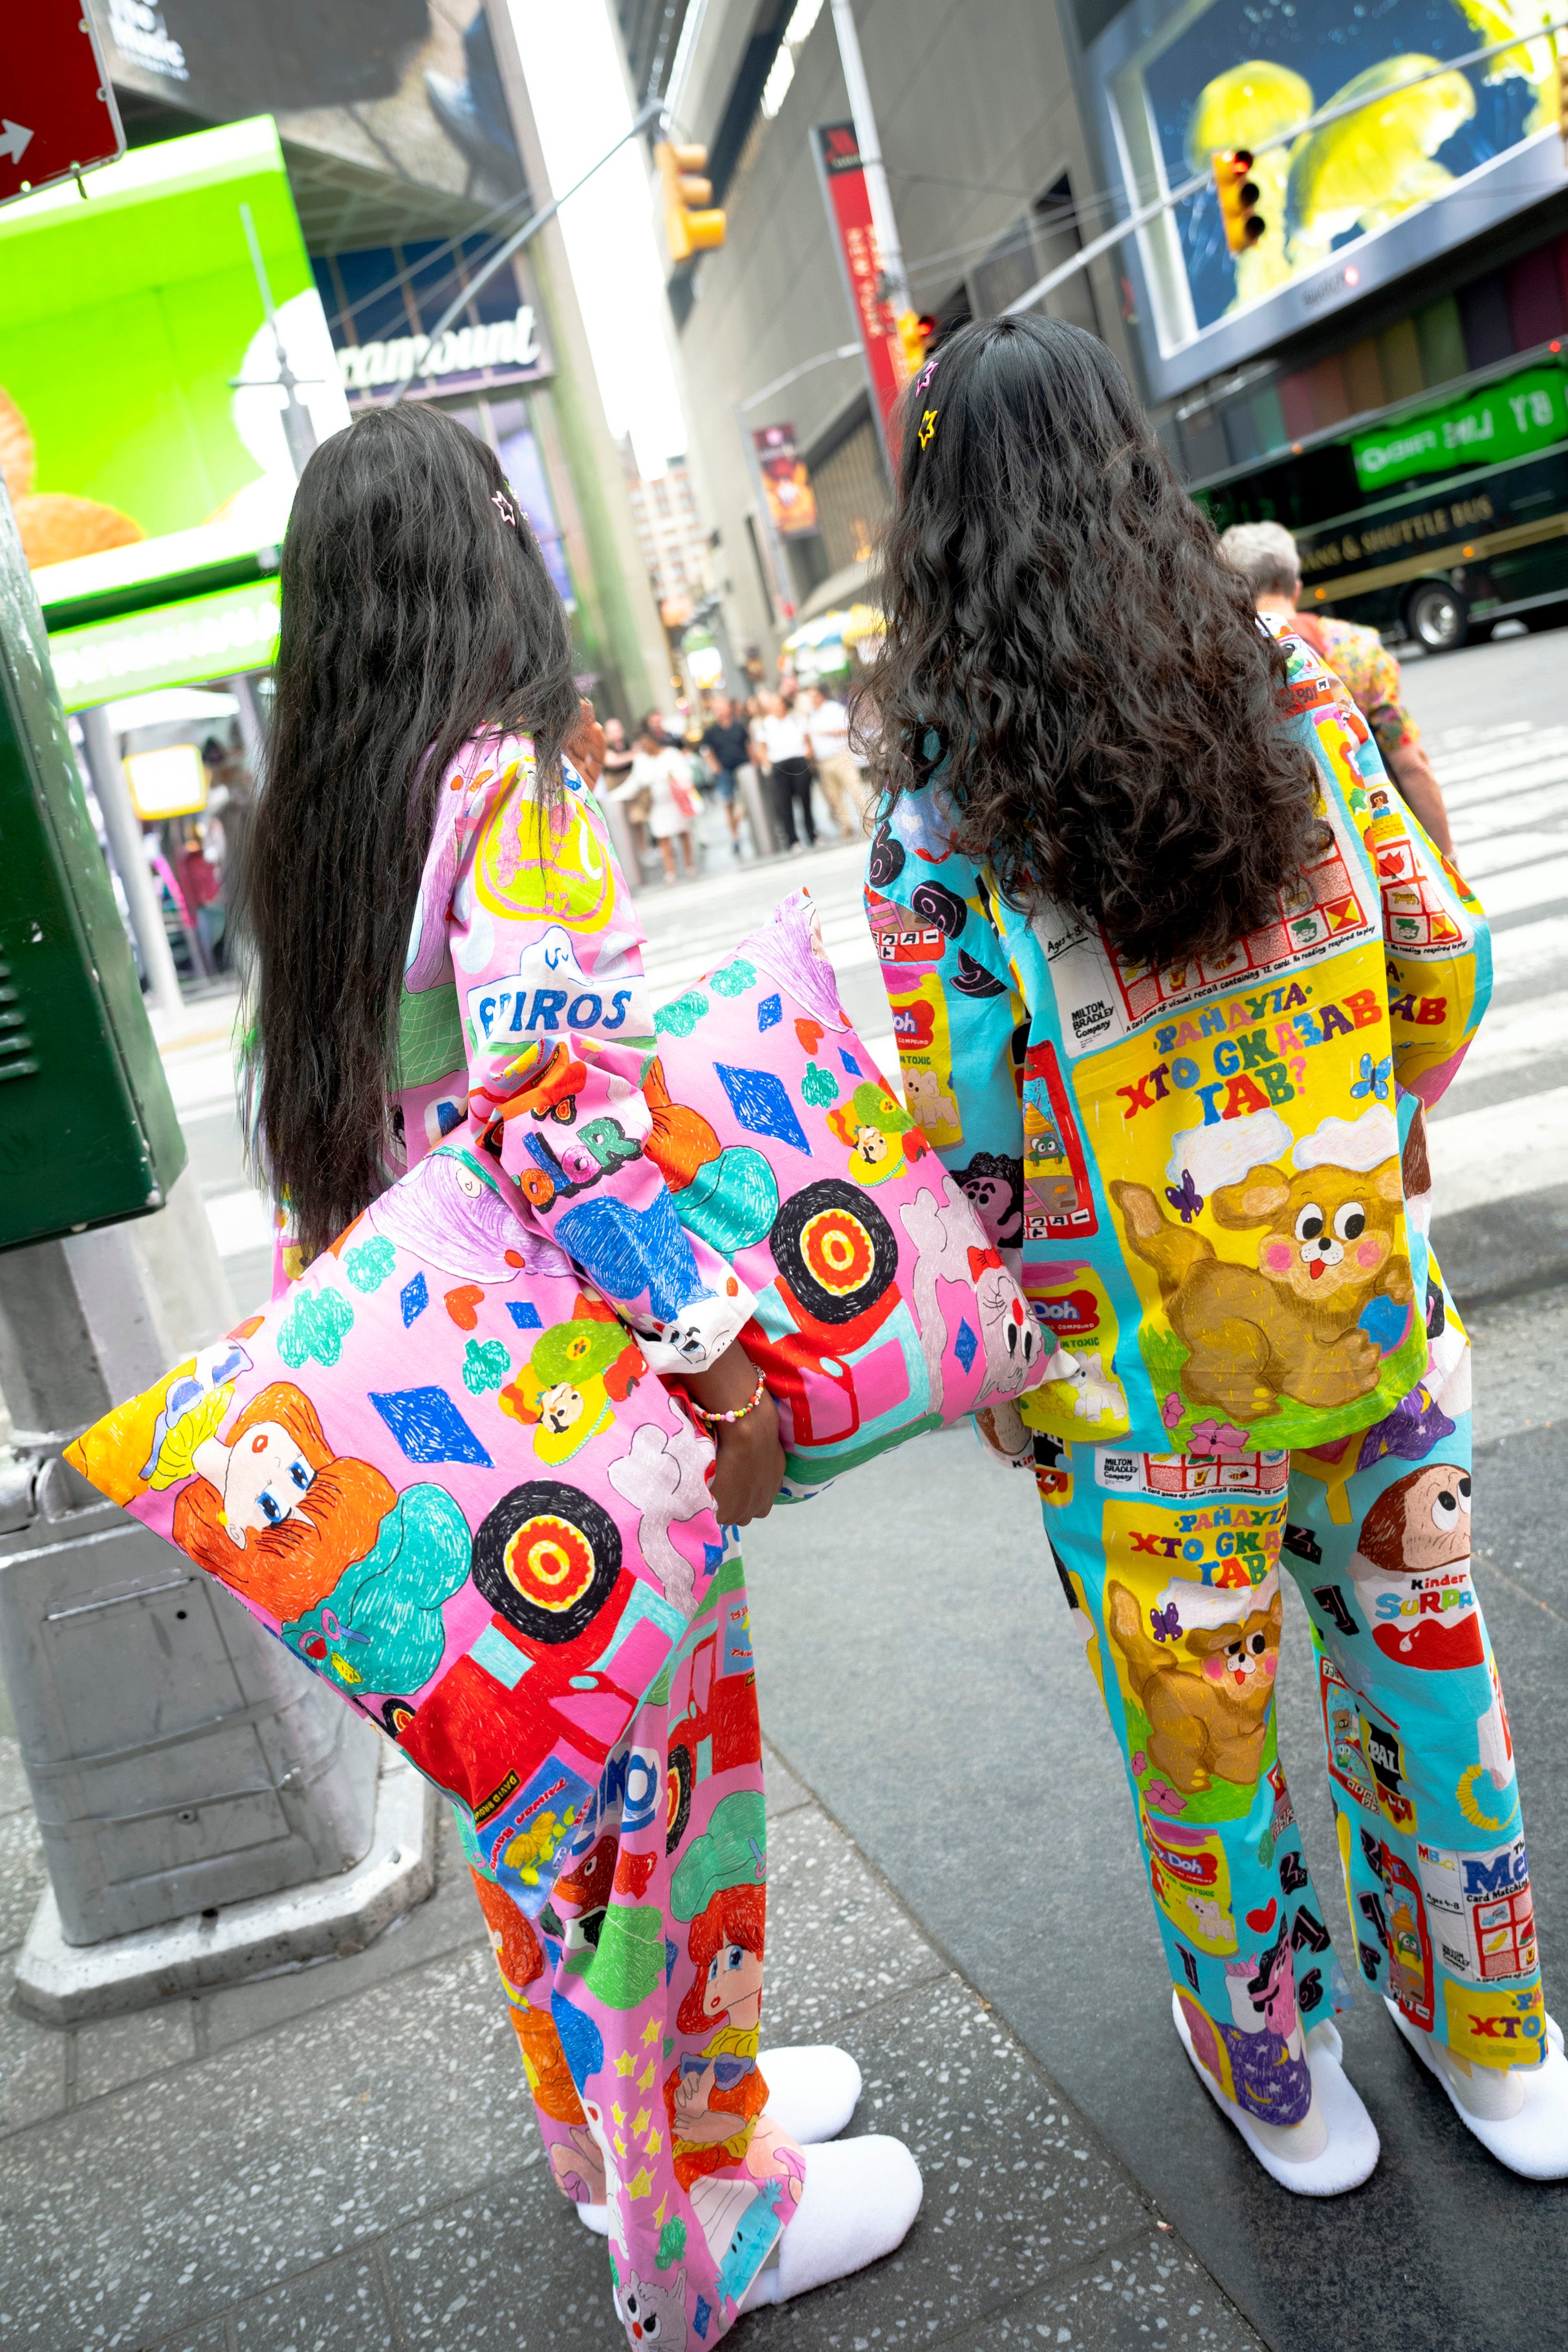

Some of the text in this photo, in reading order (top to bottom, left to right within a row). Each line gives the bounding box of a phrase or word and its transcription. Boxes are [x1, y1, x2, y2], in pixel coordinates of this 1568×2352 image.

[1452, 494, 1494, 527] BUS
[1047, 938, 1066, 953] Ages
[1399, 946, 1421, 955] reading
[1424, 945, 1451, 954] required
[1457, 940, 1468, 950] play
[1144, 1010, 1157, 1022] game
[1158, 1003, 1167, 1013] of
[1168, 994, 1192, 1008] visual
[1193, 984, 1218, 999] recall
[1221, 969, 1259, 989] containing
[1294, 953, 1300, 963] No
[1301, 946, 1327, 962] reading
[1328, 933, 1355, 949] required
[1356, 930, 1363, 939] to
[1363, 925, 1376, 937] play
[1071, 1001, 1105, 1021] MILTON
[1073, 1006, 1115, 1030] BRADLEY
[1076, 1019, 1111, 1039] Company
[898, 1037, 929, 1045] COMPOUND
[906, 1055, 931, 1065] TOXIC
[1071, 1336, 1100, 1347] TOXIC
[1104, 1465, 1138, 1474] BRADLEY
[1104, 1472, 1133, 1481] Company
[1229, 1486, 1262, 1495] containing
[1411, 1573, 1467, 1591] Kinder
[1367, 1739, 1400, 1774] PAL
[492, 1774, 518, 1802] DAVID
[1418, 1844, 1440, 1863] MB
[1426, 1893, 1444, 1905] Ages
